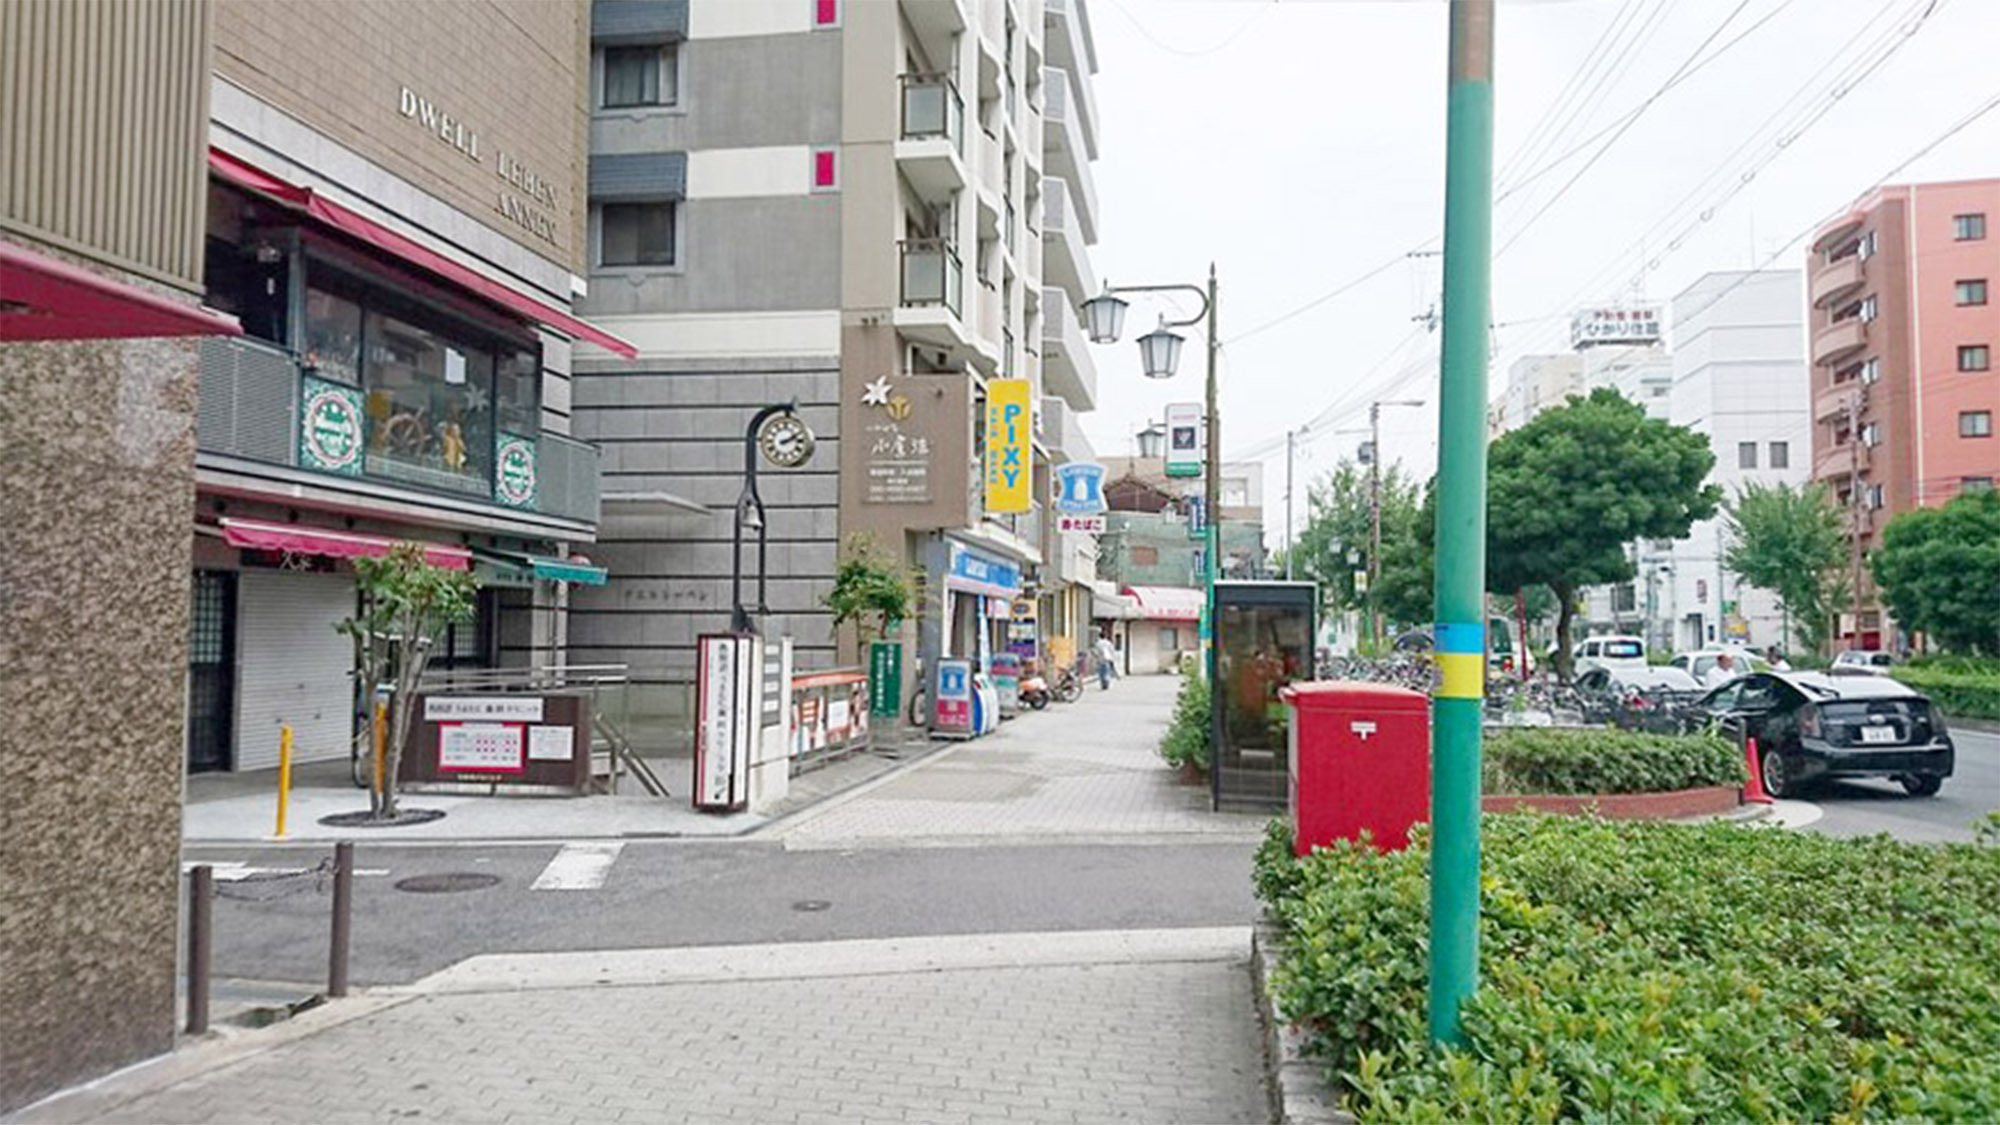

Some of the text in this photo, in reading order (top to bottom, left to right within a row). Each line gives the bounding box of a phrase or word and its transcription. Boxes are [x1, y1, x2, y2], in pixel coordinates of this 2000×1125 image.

[399, 86, 557, 211] DWELL LEBEN
[494, 192, 557, 246] ANNEX
[1585, 321, 1659, 336] ひかり住
[1003, 404, 1021, 488] PIXY
